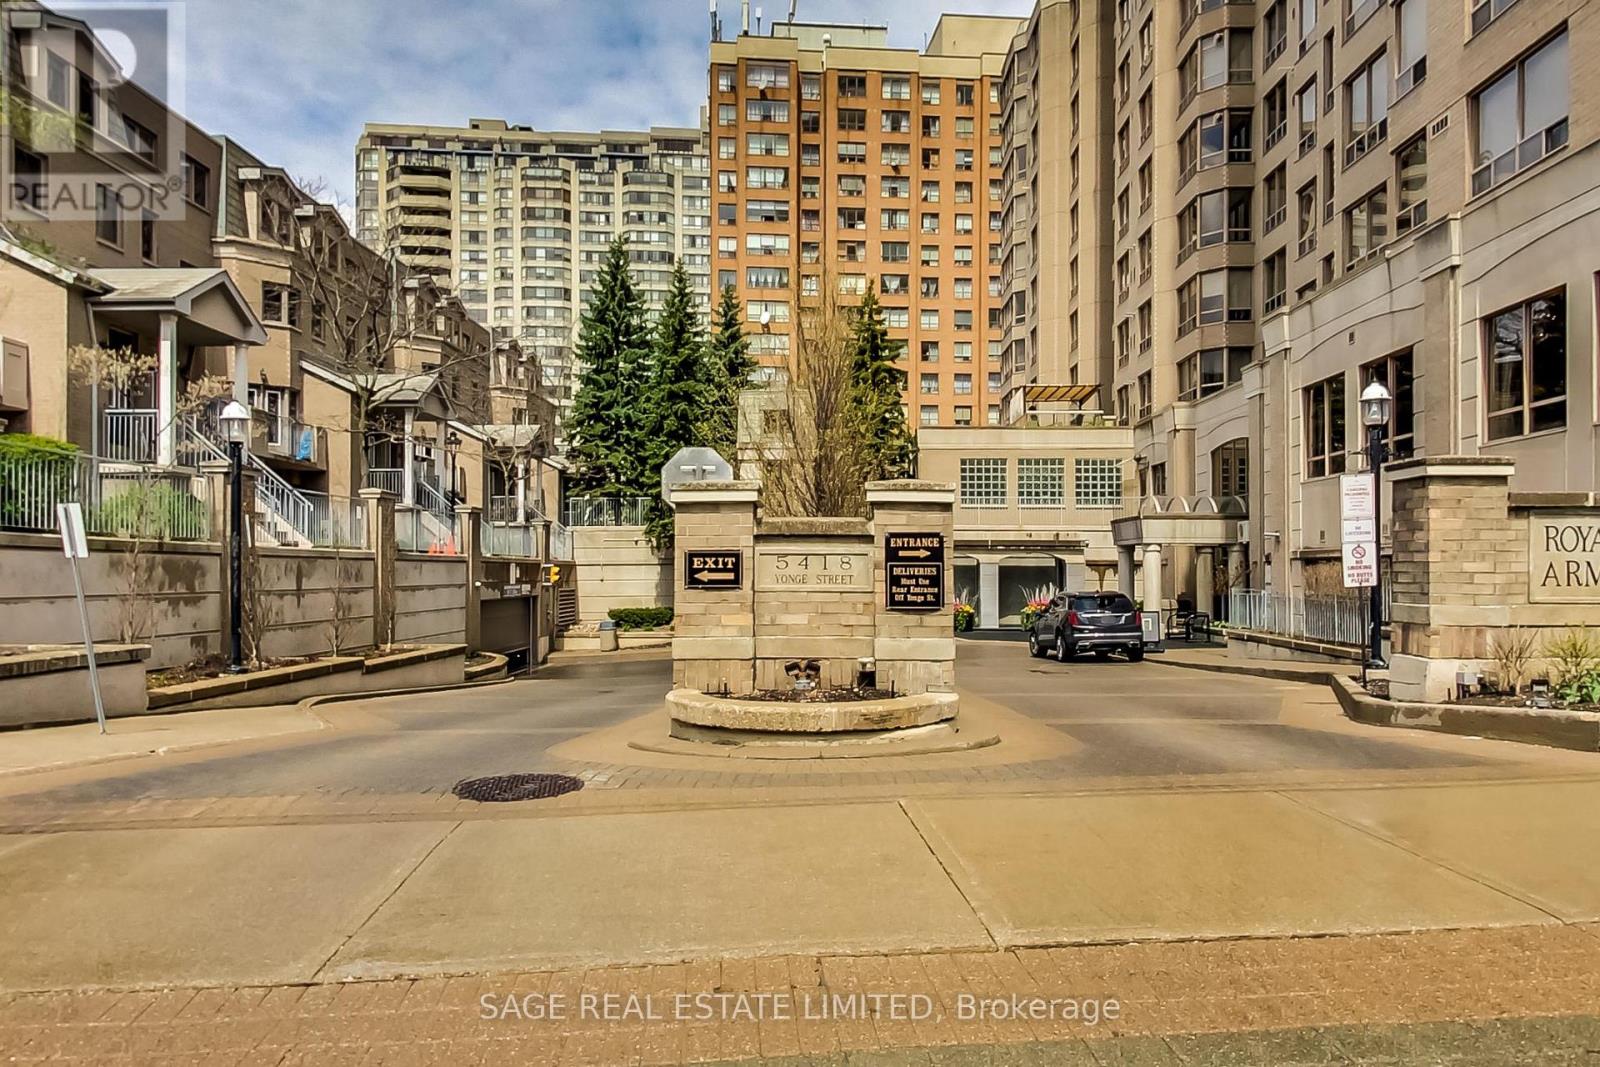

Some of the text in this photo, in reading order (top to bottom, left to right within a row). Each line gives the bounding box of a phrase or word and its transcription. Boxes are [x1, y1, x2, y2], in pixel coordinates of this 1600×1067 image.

[890, 537, 940, 547] ENTRANCE
[692, 557, 736, 568] EXIT
[775, 555, 852, 570] 5418
[893, 567, 937, 575] DELIVERIES
[775, 573, 854, 585] YONGE STREET
